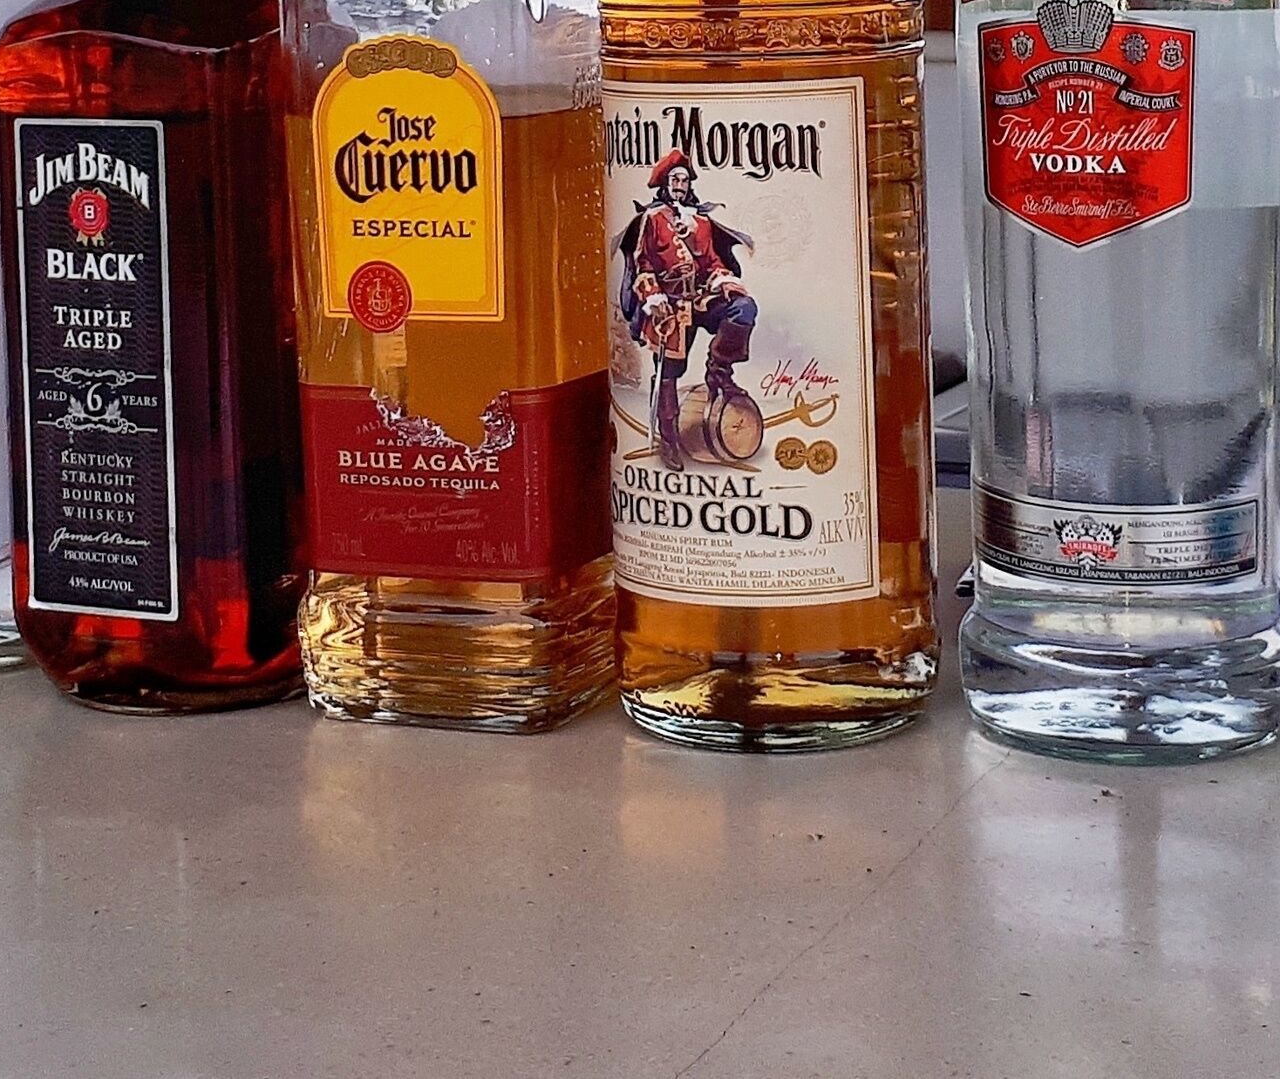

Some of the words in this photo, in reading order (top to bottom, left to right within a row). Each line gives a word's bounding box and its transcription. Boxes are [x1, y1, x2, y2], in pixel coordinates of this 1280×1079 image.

[1032, 60, 1068, 79] PURVEYOR
[1069, 60, 1079, 72] TO
[1080, 61, 1094, 74] THE
[1094, 65, 1128, 86] RUSSIAN
[1077, 90, 1094, 114] 21
[1151, 96, 1175, 109] COURT
[377, 107, 437, 148] Jose
[992, 114, 1055, 161] Triple
[1053, 117, 1178, 152] Distilled
[662, 106, 823, 181] Morgan
[334, 130, 478, 204] Cuervo
[1029, 152, 1127, 174] VODKA
[28, 151, 75, 206] JIM
[77, 143, 151, 210] BEAM
[352, 219, 472, 238] ESPECIAL
[46, 249, 137, 282] BLACK
[53, 306, 133, 329] TRIPLE
[63, 328, 122, 351] AGED
[37, 390, 68, 401] AGED
[86, 382, 103, 412] 6
[122, 395, 158, 407] YEARS
[376, 438, 413, 447] MADE
[61, 451, 134, 469] KENTUCKY
[338, 450, 403, 469] BLUE
[412, 453, 500, 473] AGAVE
[61, 470, 135, 487] STRAIGHT
[340, 473, 425, 487] REPOSADO
[429, 477, 501, 491] TEQUILA
[624, 465, 763, 498] ORIGINAL
[62, 487, 135, 505] BOURBON
[843, 491, 864, 516] 35%
[62, 506, 135, 524] WHISKEY
[612, 482, 693, 528] SPICED
[700, 501, 813, 541] GOLD
[679, 537, 709, 547] SPIRIT
[819, 519, 844, 544] ALK
[64, 549, 107, 563] PRODUCT
[107, 554, 121, 564] OF
[121, 555, 138, 566] USA
[752, 578, 807, 589] DILARANG
[777, 567, 836, 578] INDONESIA
